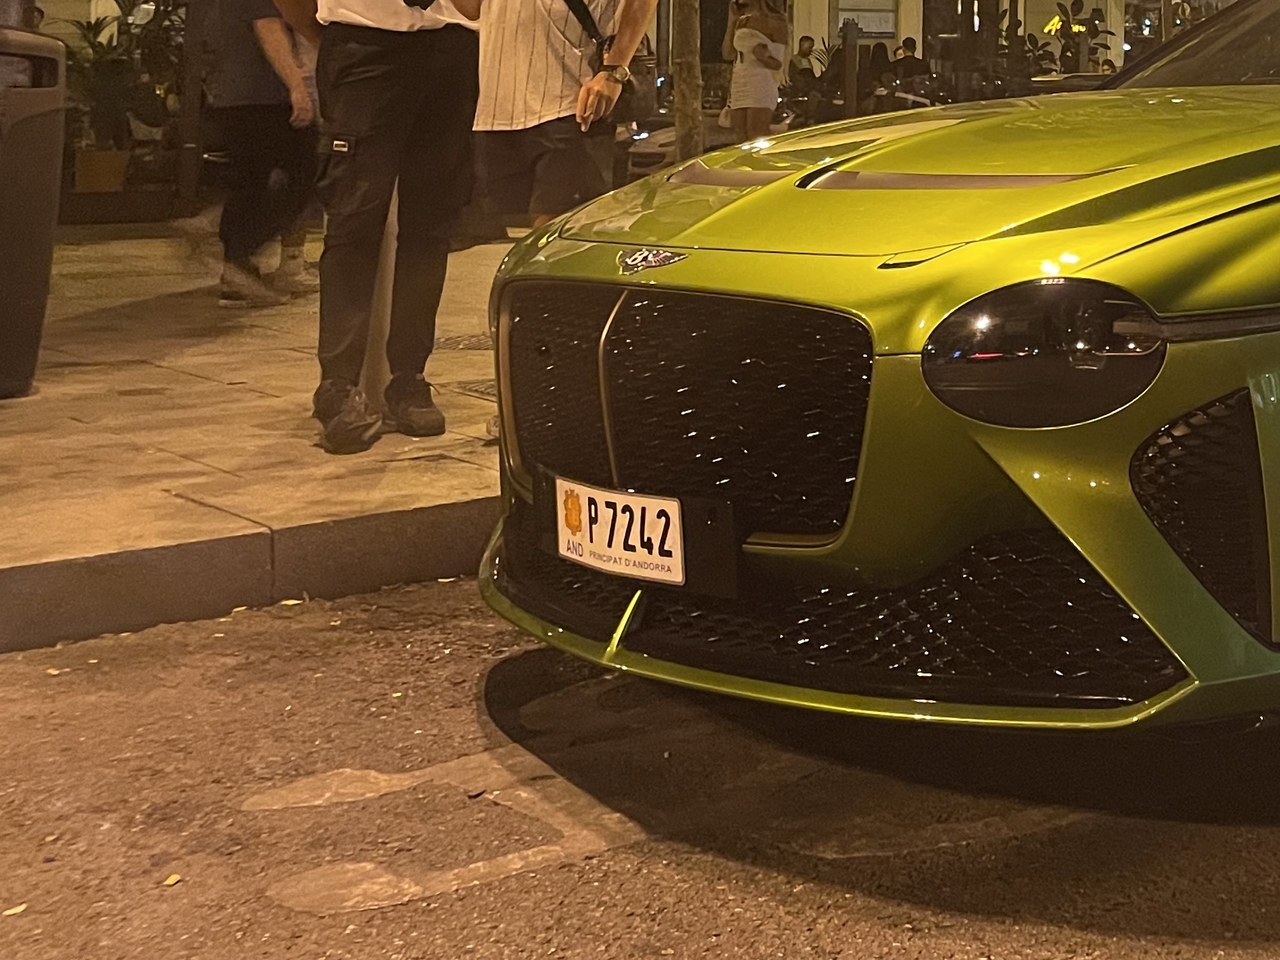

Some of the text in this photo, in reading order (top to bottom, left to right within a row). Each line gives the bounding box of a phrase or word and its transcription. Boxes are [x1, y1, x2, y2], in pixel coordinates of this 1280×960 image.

[566, 538, 584, 558] AND
[589, 549, 673, 574] PRINCIPAT D'ANDORRA
